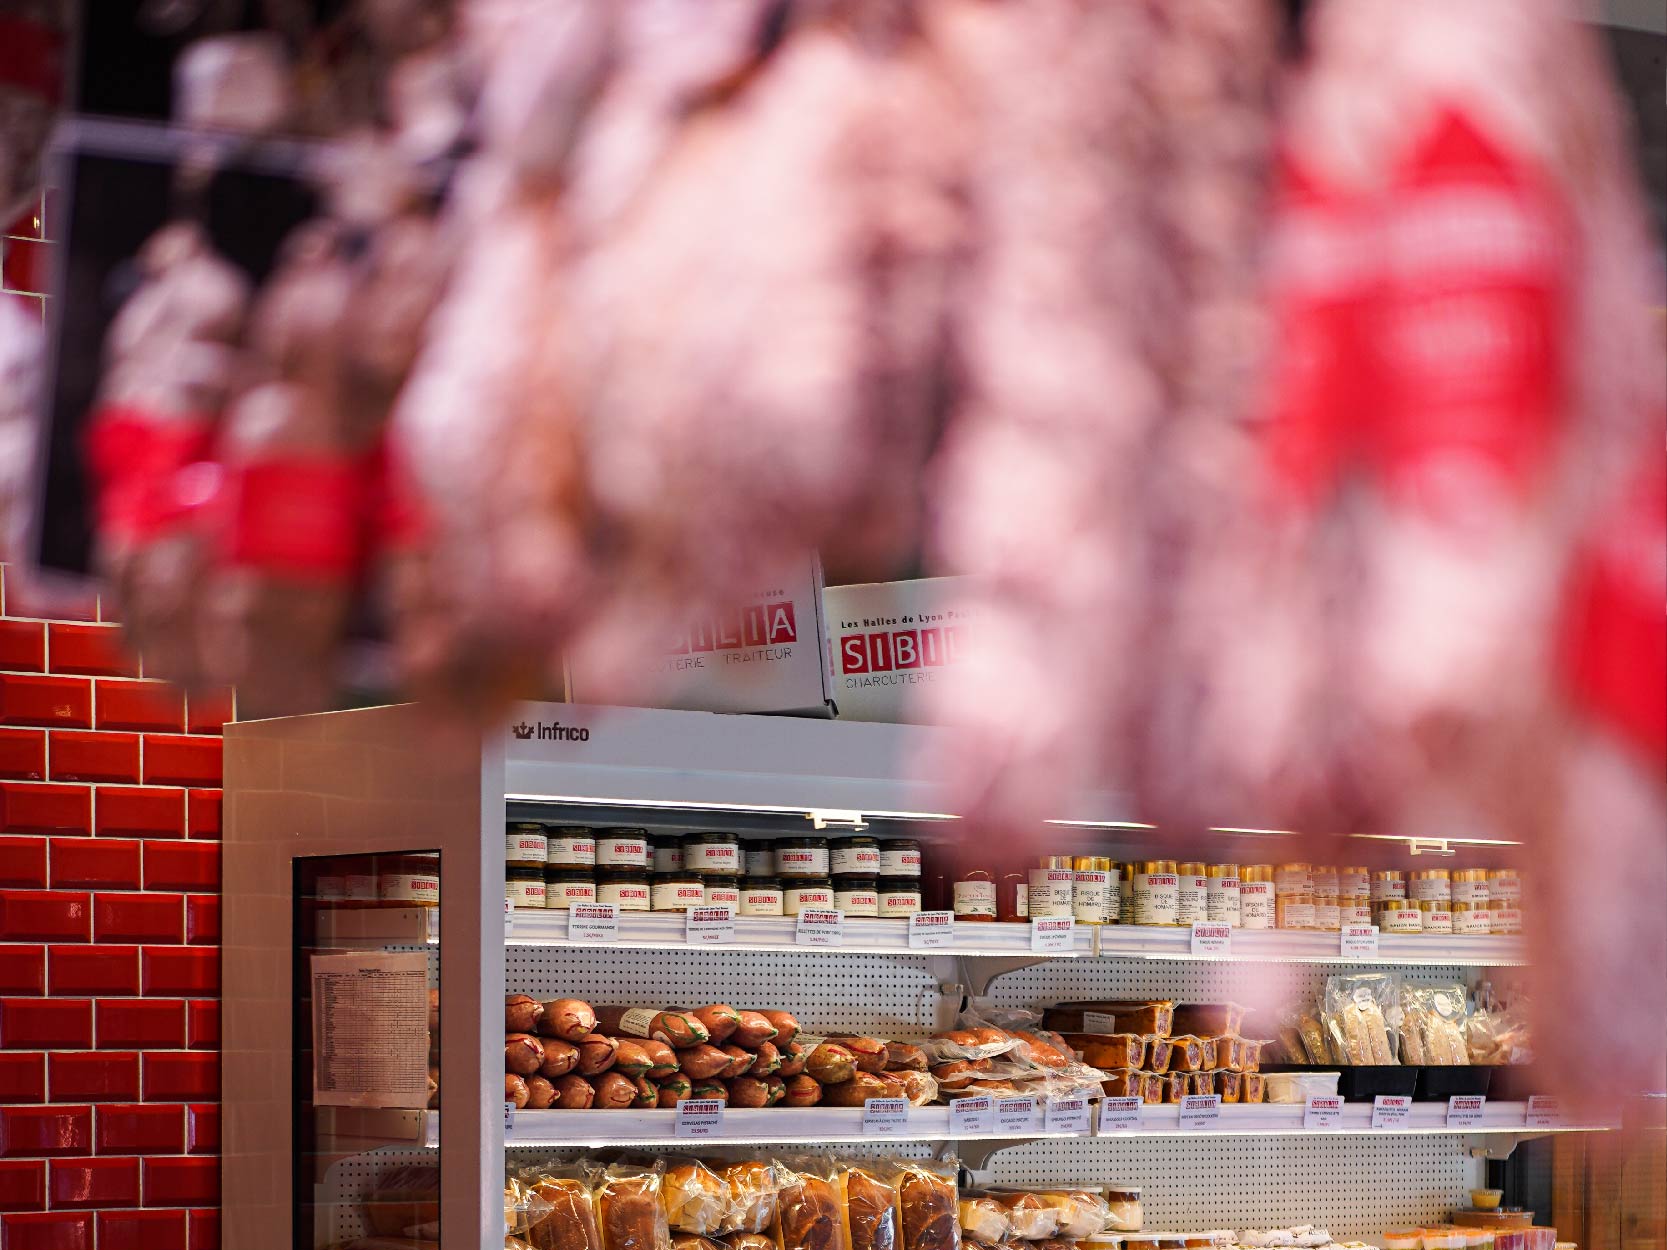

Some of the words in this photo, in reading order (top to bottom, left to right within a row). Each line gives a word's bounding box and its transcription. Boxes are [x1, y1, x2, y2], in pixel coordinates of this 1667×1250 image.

[841, 620, 859, 629] Les
[864, 617, 897, 628] Halles
[902, 615, 914, 624] de
[918, 613, 943, 625] Lyon
[722, 647, 792, 665] TRAITEUR
[846, 671, 936, 689] CHARCUTERIE
[537, 721, 590, 742] Infrico
